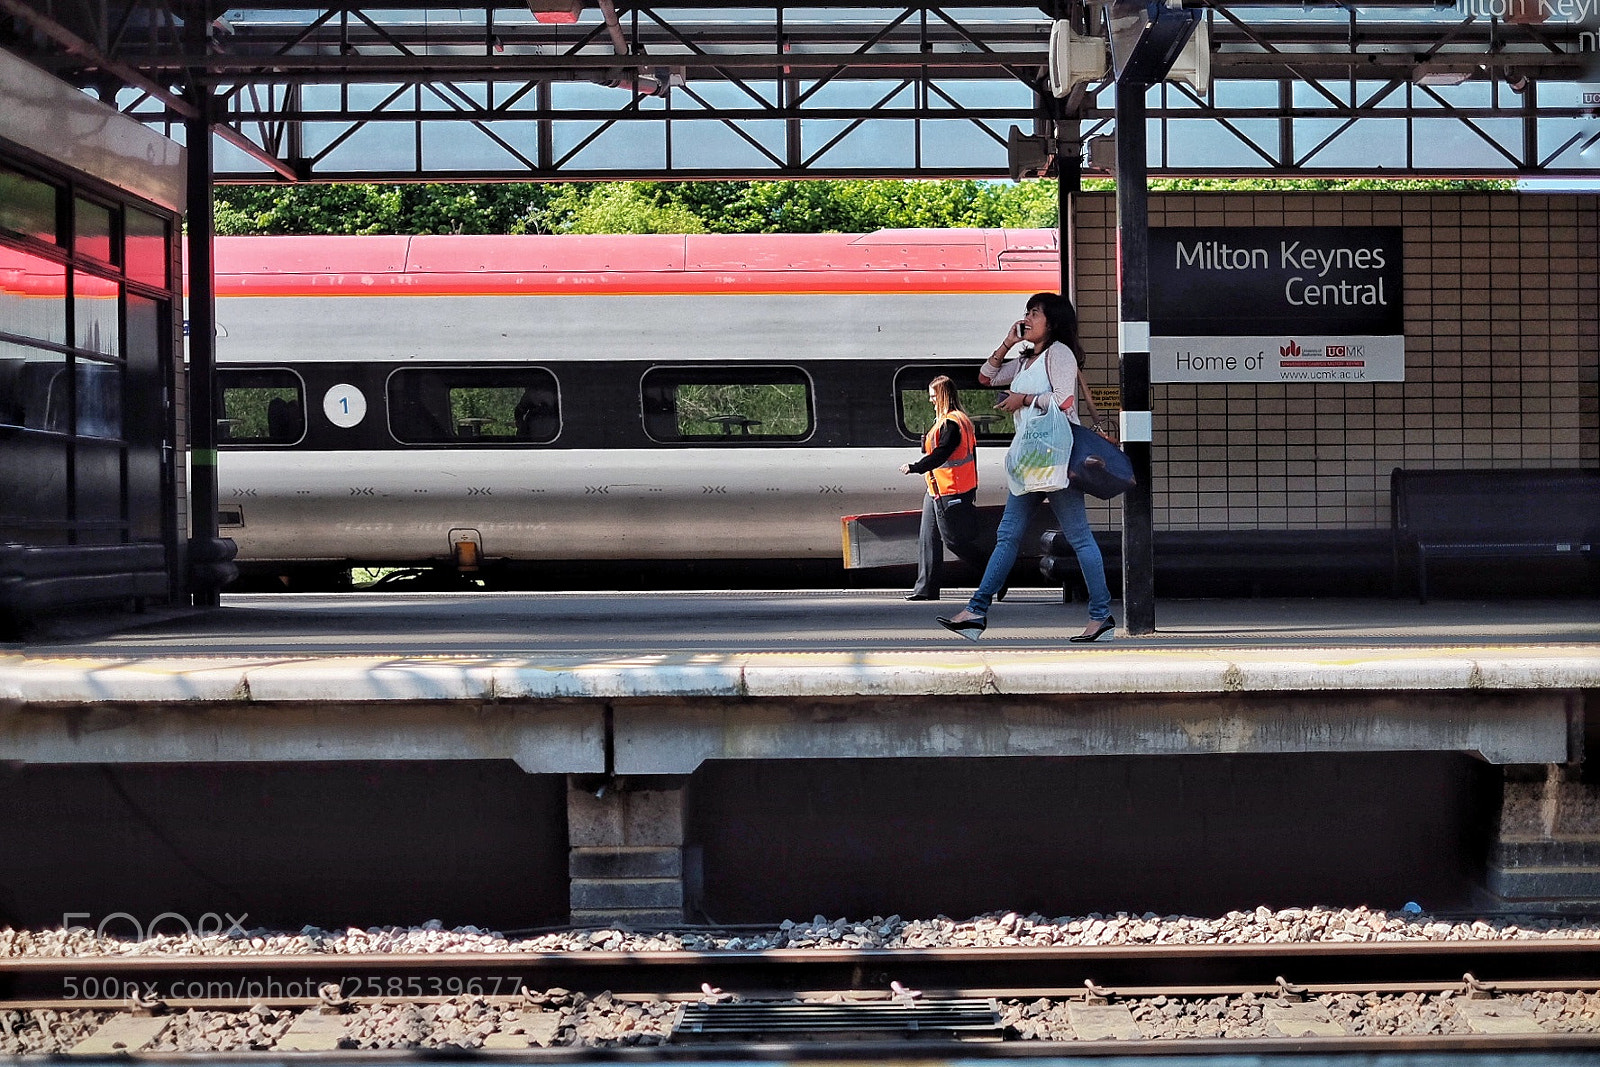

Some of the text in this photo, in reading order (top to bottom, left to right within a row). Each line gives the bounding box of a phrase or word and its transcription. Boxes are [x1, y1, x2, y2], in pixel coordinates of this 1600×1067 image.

[1176, 241, 1386, 277] Milton Keynes
[1285, 277, 1387, 306] Central
[1176, 351, 1264, 370] Home of
[1280, 370, 1365, 379] www.ucmk.ac.uk
[339, 396, 349, 414] 1
